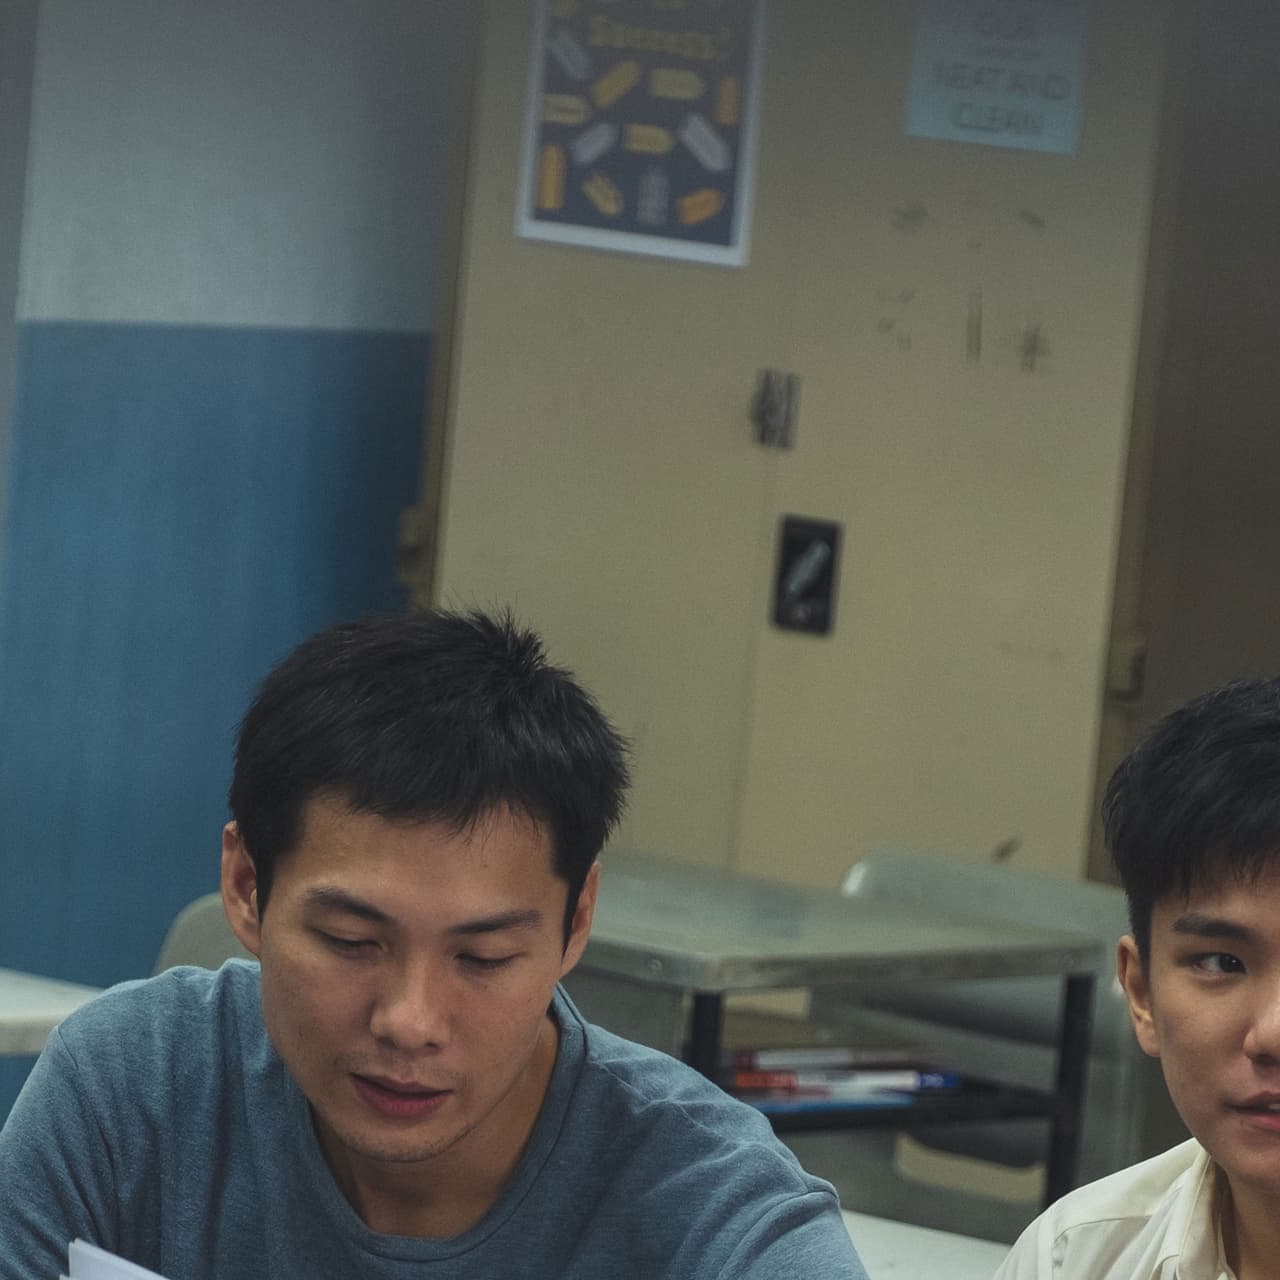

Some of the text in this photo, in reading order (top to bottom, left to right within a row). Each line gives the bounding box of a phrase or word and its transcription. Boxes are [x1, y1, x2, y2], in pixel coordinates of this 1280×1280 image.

[933, 62, 1072, 101] NEAT AND
[953, 101, 1045, 136] CLEAN
